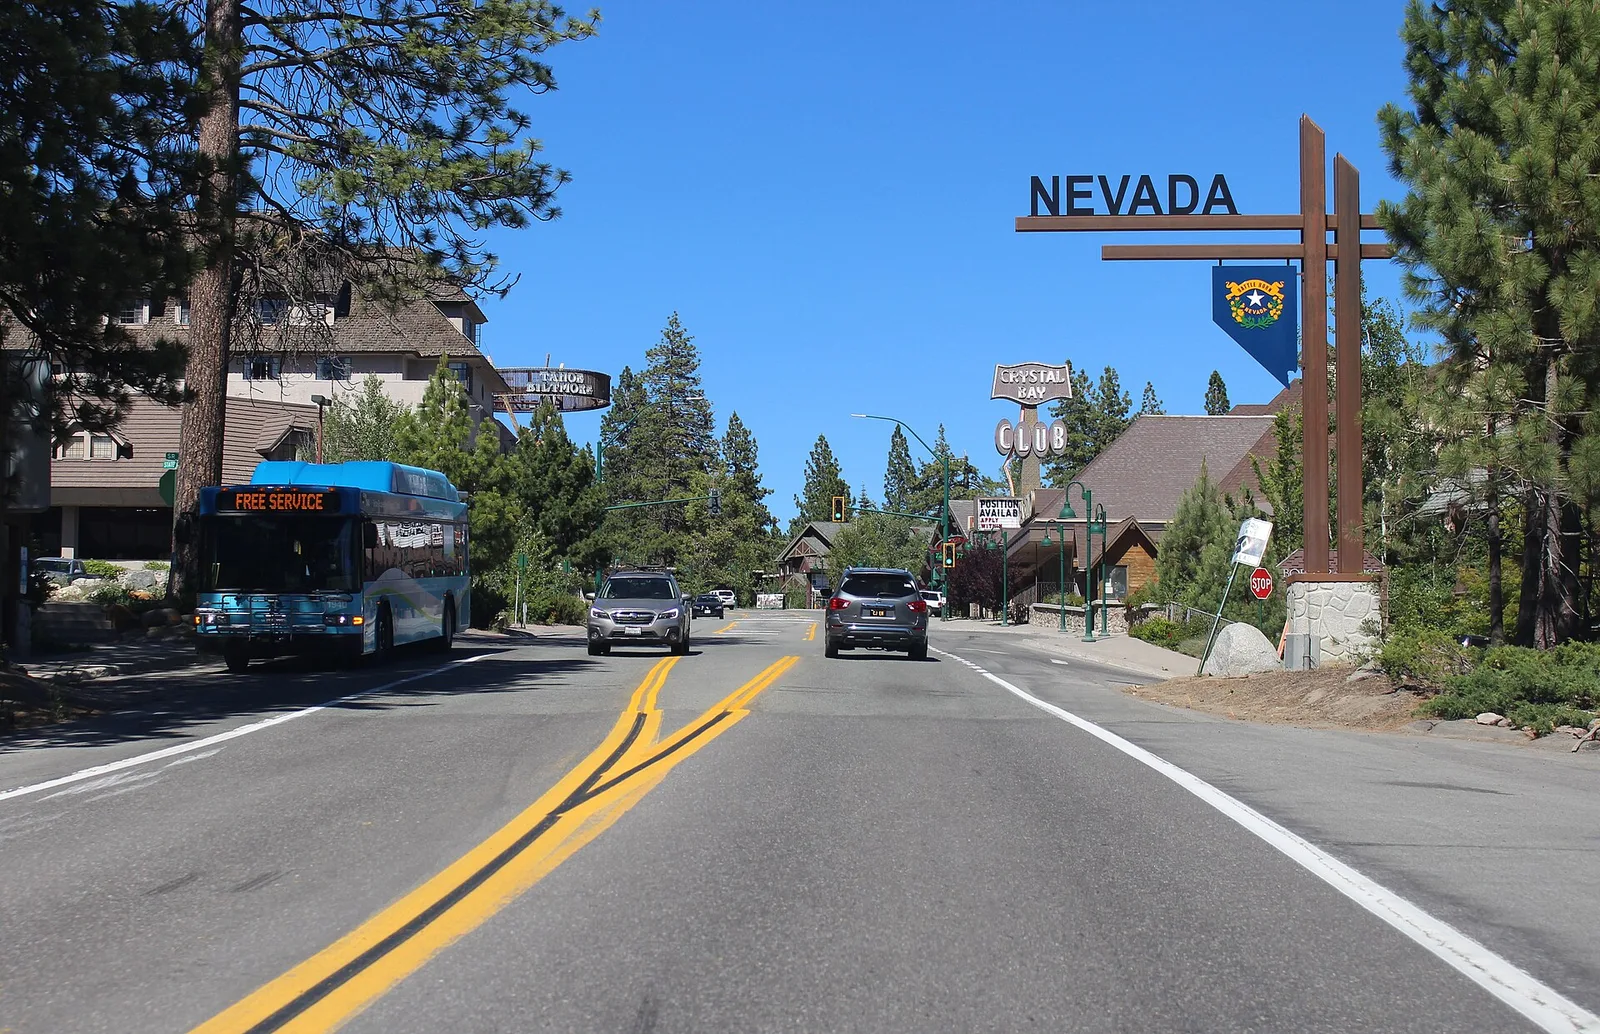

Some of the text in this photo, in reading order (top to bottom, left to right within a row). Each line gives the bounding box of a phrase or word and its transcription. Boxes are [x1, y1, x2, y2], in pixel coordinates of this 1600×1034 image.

[1030, 174, 1239, 216] NEVADA
[1244, 306, 1268, 315] NEVADA
[540, 371, 585, 384] TAHOE
[1000, 369, 1066, 383] CRYSTAL
[526, 381, 594, 395] BILTMORE
[1017, 386, 1046, 399] BAY
[1000, 425, 1064, 452] CLUB
[235, 493, 324, 510] FREE SERVICE
[980, 500, 1018, 508] POSITION
[980, 509, 1018, 517] AVAILAB
[1252, 578, 1271, 590] STOP
